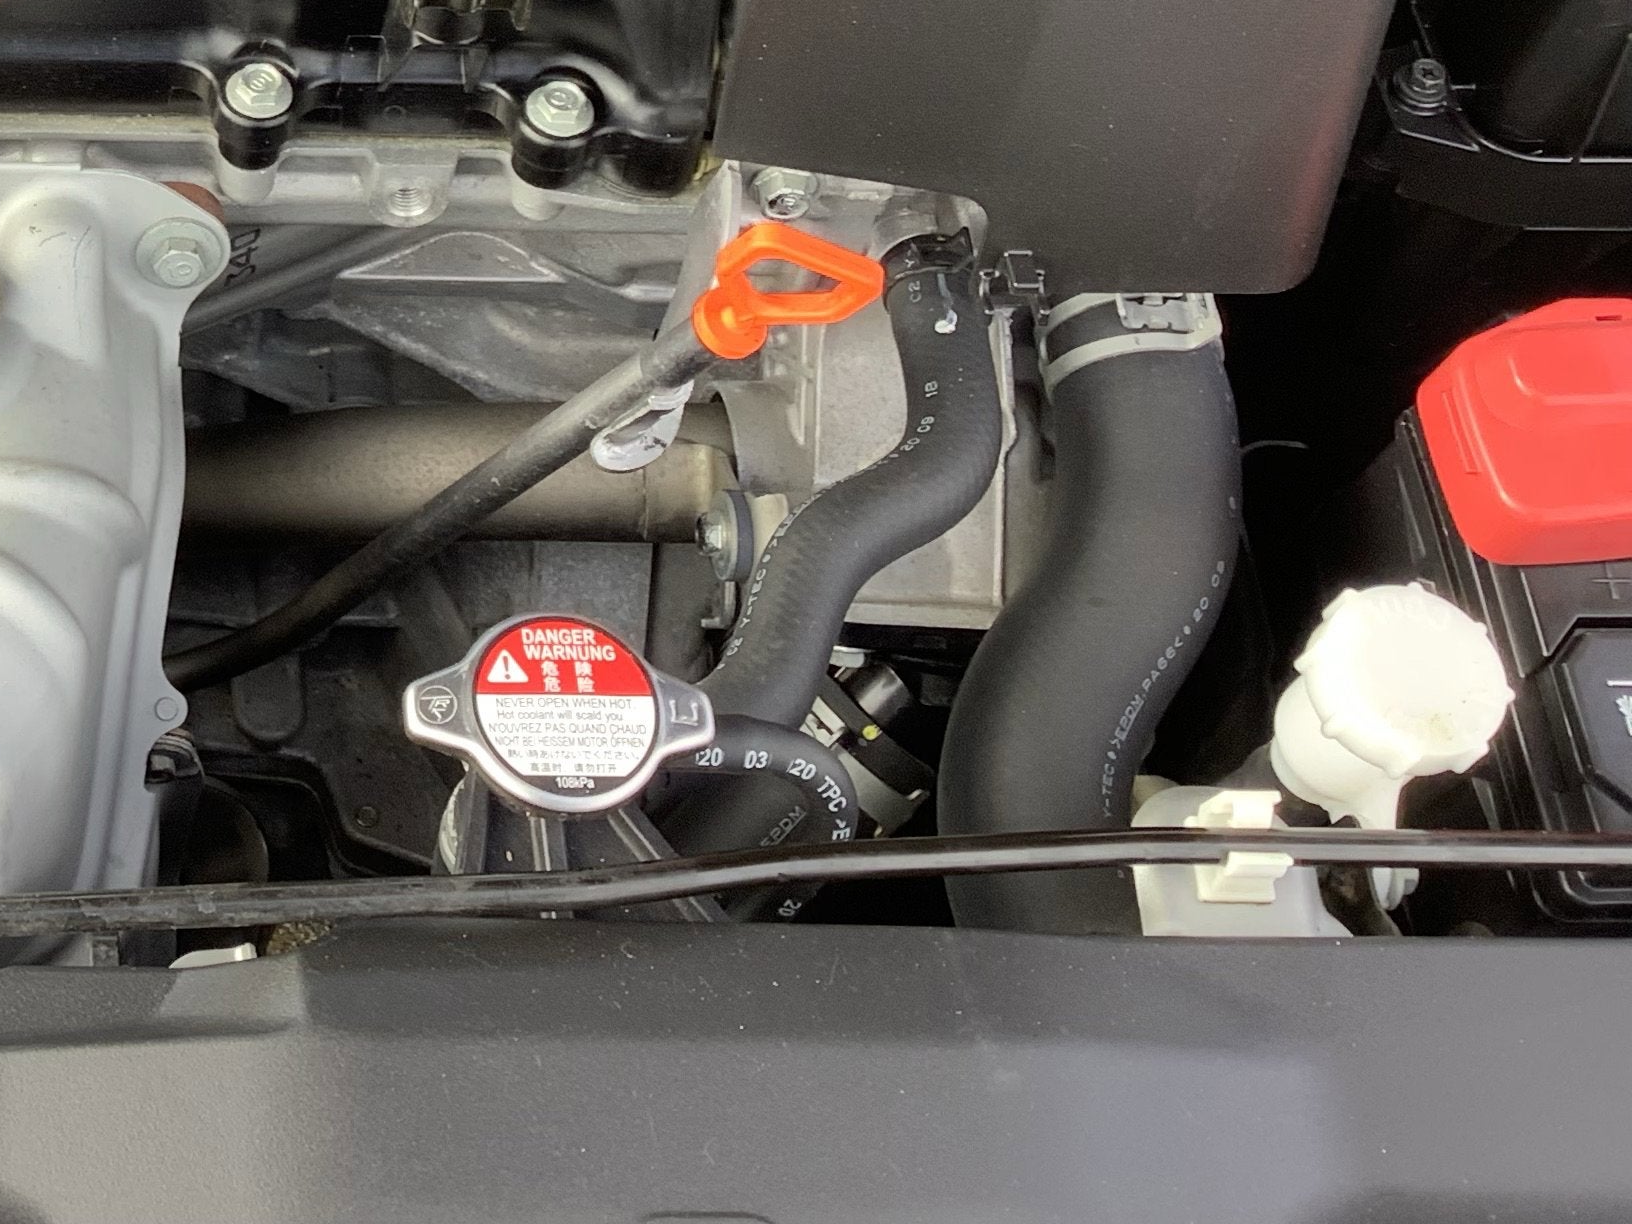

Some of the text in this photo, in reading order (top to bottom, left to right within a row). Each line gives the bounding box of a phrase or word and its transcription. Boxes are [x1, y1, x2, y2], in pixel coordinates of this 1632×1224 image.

[900, 436, 921, 452] 20
[521, 628, 597, 645] DANGER
[523, 644, 617, 662] WARNUNG
[495, 697, 534, 708] NEVER
[537, 697, 569, 708] OPEN
[572, 698, 606, 709] WHEN
[1103, 762, 1117, 818] Y-TEC
[1193, 597, 1210, 622] 20
[497, 709, 514, 720] Hot
[517, 709, 554, 720] coolant
[557, 709, 573, 720] will
[575, 709, 602, 721] scald
[544, 722, 567, 733] PAS
[568, 722, 607, 734] QUAND
[495, 735, 520, 747] NICHT
[537, 735, 575, 747] HEISSEM
[577, 736, 608, 748] MOTOR
[697, 747, 724, 767] 20
[744, 750, 768, 769] 03
[789, 758, 817, 780] 20
[817, 776, 847, 812] TPC
